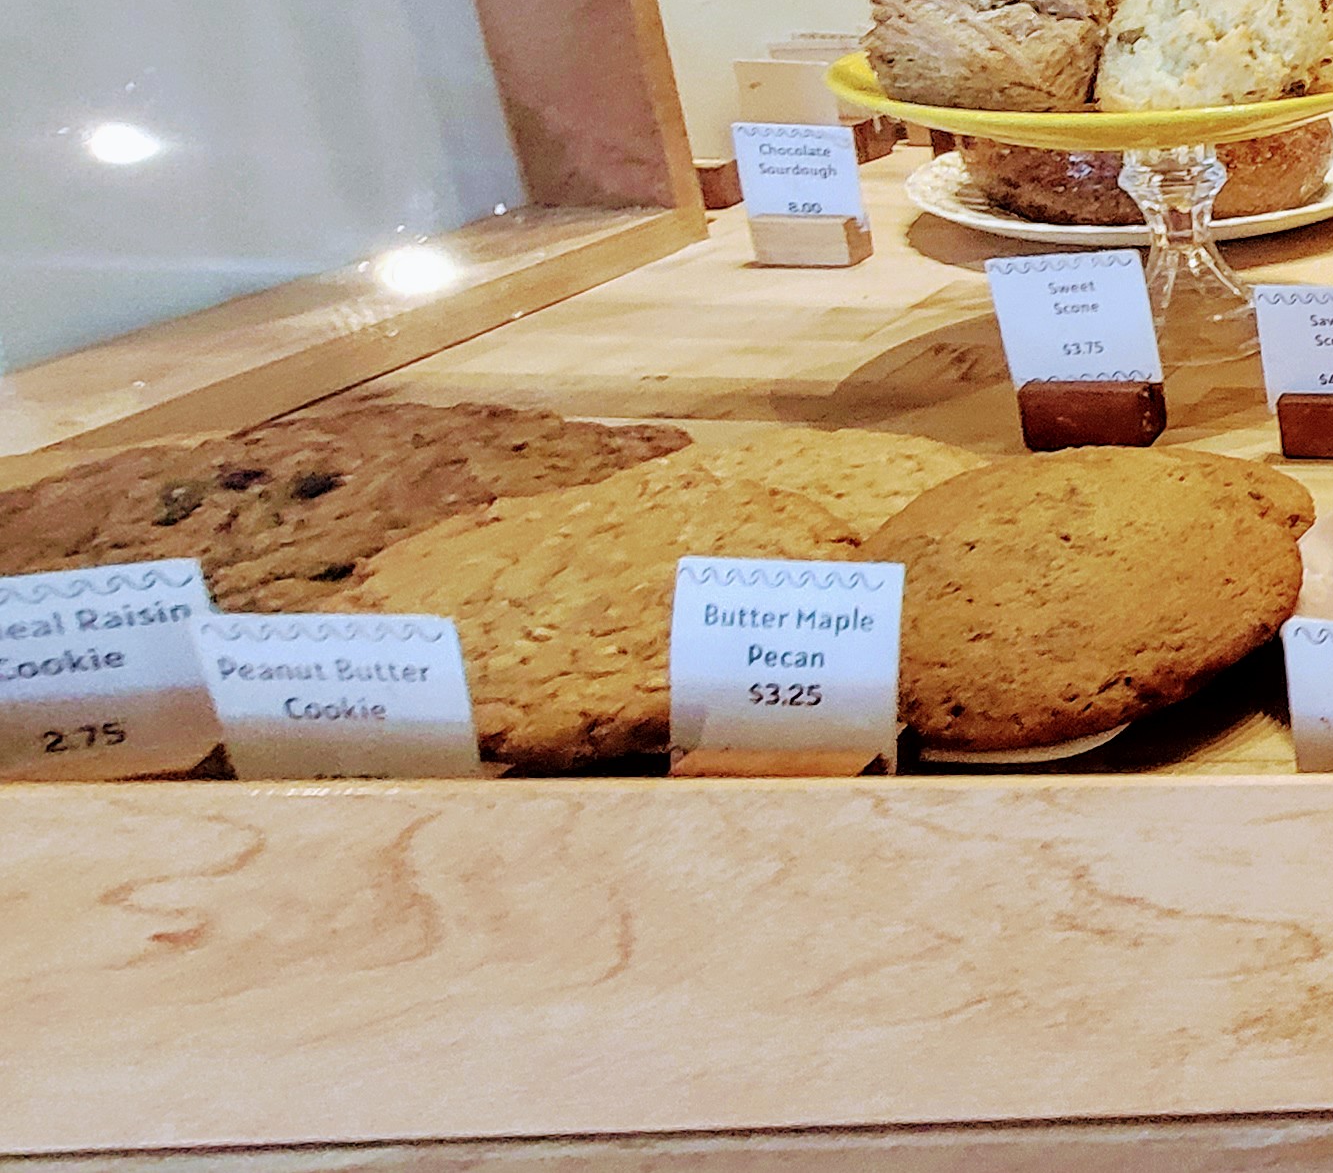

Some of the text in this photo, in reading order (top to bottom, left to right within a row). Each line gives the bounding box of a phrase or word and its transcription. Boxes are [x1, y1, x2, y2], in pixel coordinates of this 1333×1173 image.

[758, 143, 832, 158] Chocolate
[758, 162, 838, 179] Sourdough
[1048, 281, 1096, 295] Sweet
[1053, 302, 1100, 315] Scone
[1062, 340, 1105, 356] $3.75
[75, 600, 193, 632] Raisin
[704, 603, 875, 637] Butter Maple
[0, 647, 126, 681] Cookie
[748, 643, 826, 668] Pecan
[217, 655, 430, 682] Peanut Butter
[749, 682, 823, 708] $3.25
[284, 696, 387, 721] Cookie
